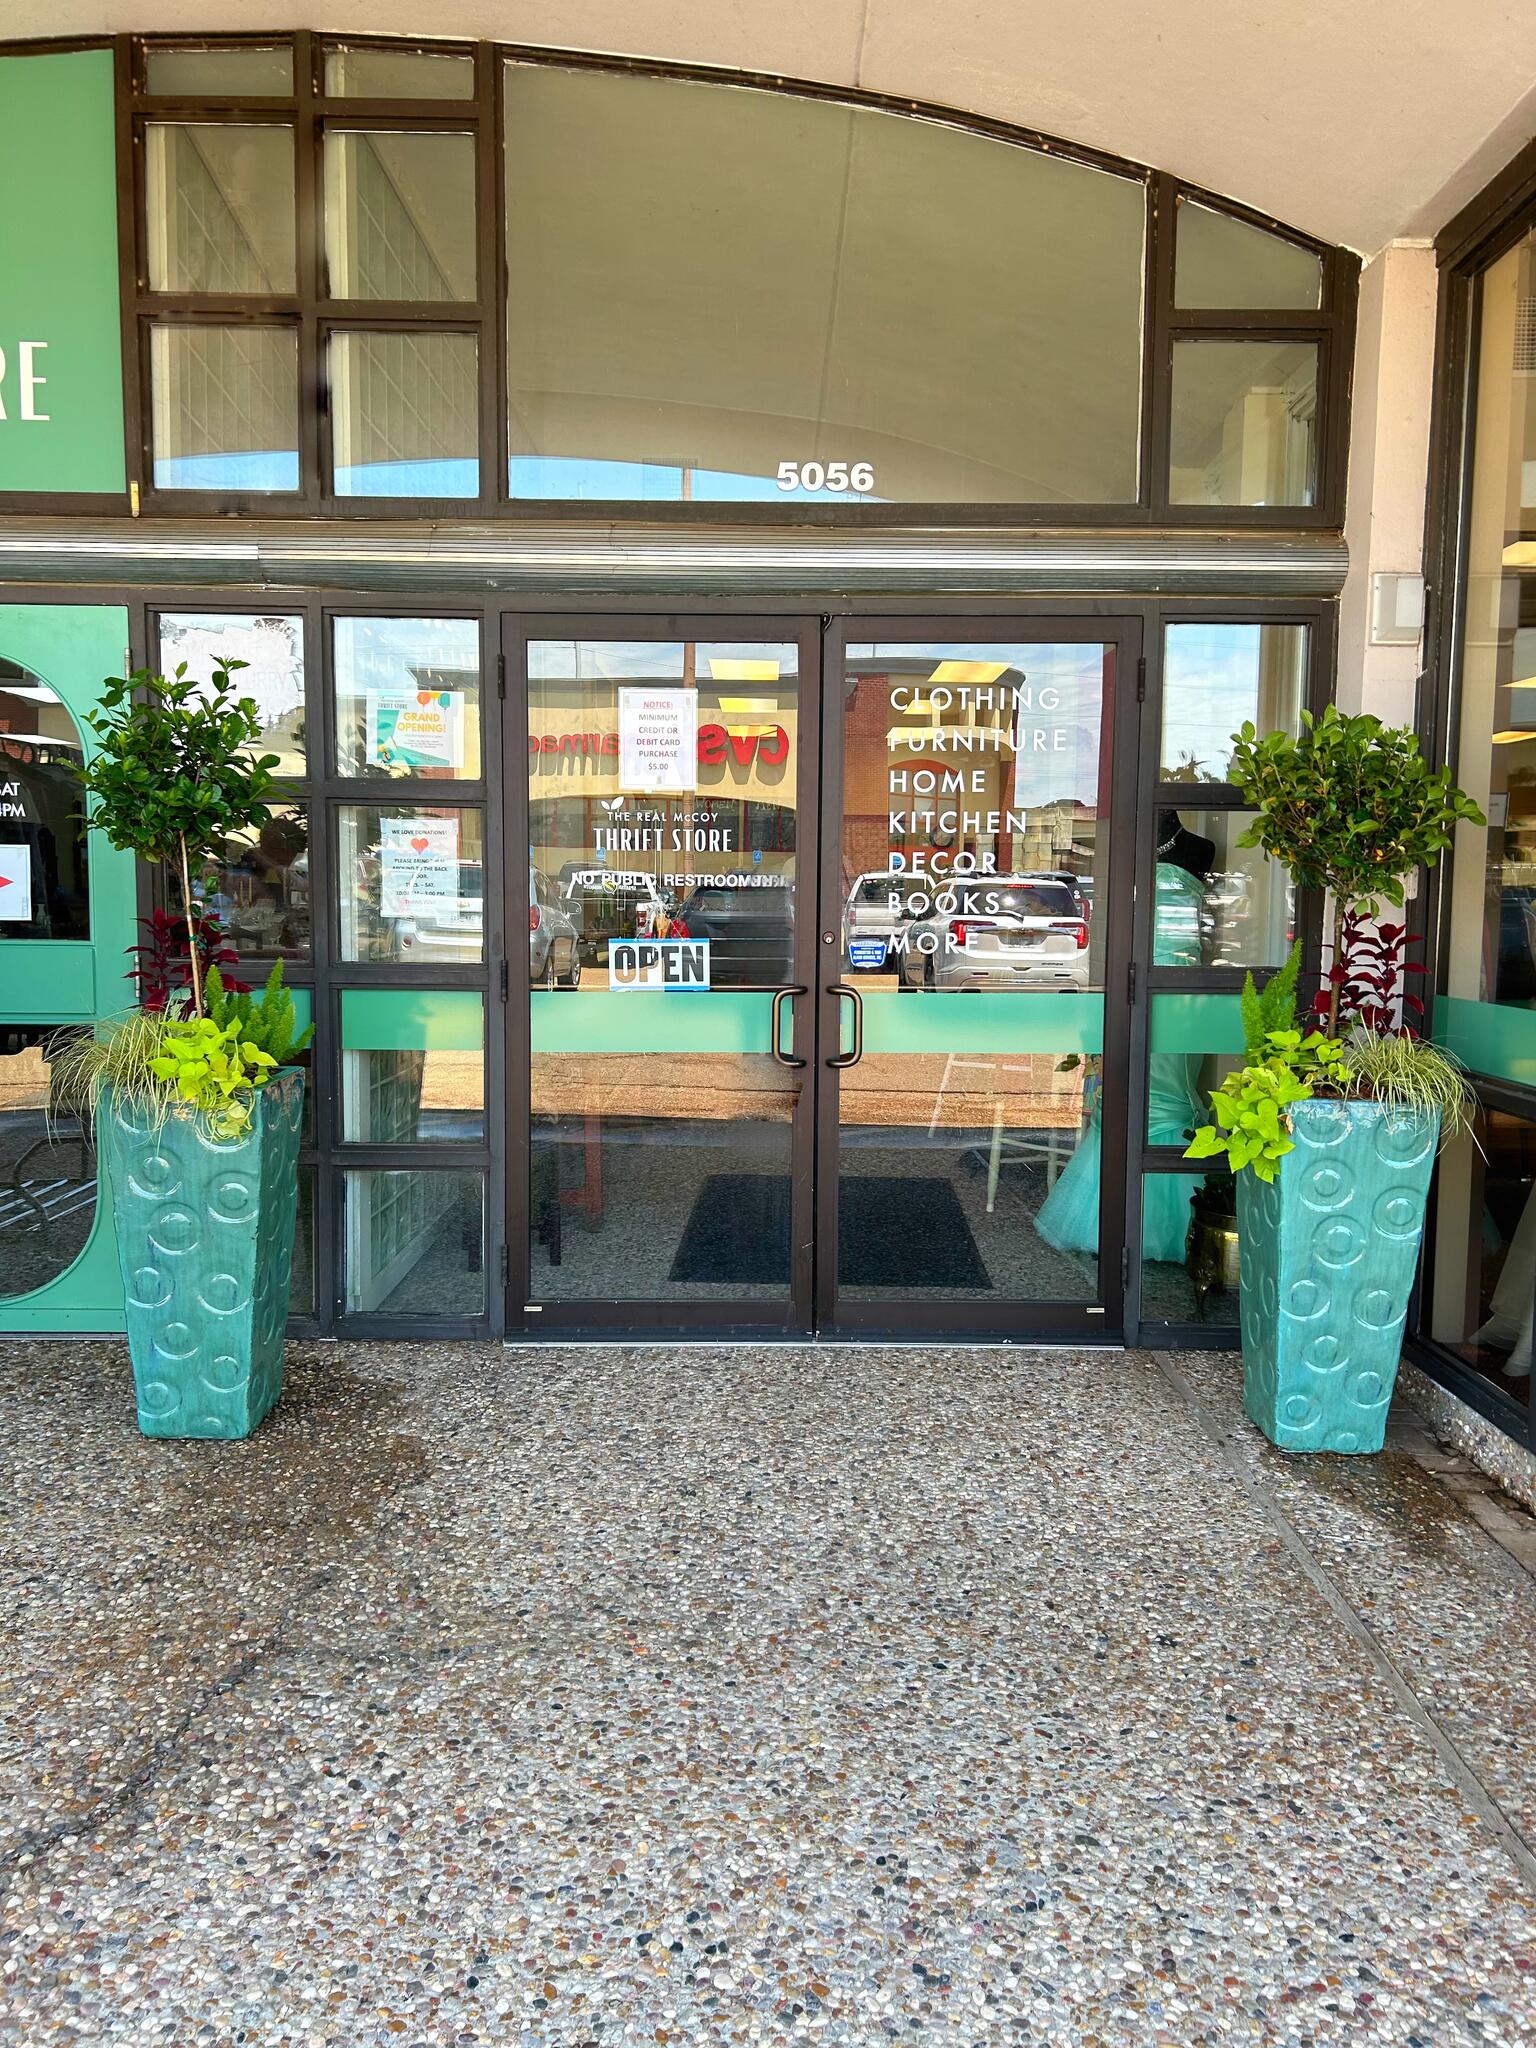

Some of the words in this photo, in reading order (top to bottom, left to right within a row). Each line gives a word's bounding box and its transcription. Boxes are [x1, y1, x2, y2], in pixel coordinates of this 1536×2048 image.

[776, 461, 874, 492] 5056
[644, 701, 672, 709] NOTICE:
[890, 687, 1061, 711] CLOTHING
[403, 712, 440, 721] GRAND
[397, 722, 447, 733] OPENING!
[638, 726, 664, 734] CREDIT
[636, 738, 658, 746] DEBIT
[659, 738, 681, 746] CARD
[889, 728, 1068, 752] FURNITURE
[638, 750, 679, 758] PURCHASE
[648, 762, 669, 771] $5.00
[0, 782, 20, 796] AT
[889, 769, 986, 793] HOME
[607, 811, 630, 821] THE
[637, 812, 667, 822] REAL
[674, 812, 719, 822] McCOY
[889, 811, 1027, 834] KITCHEN
[593, 828, 664, 851] THRIFT
[672, 828, 732, 852] STORE
[889, 852, 997, 874] DECOR
[571, 872, 595, 886] NO
[601, 872, 657, 886] PUBLIC
[888, 891, 1000, 915] BOOKS
[887, 931, 979, 955] MORE
[614, 945, 705, 983] OPEN
